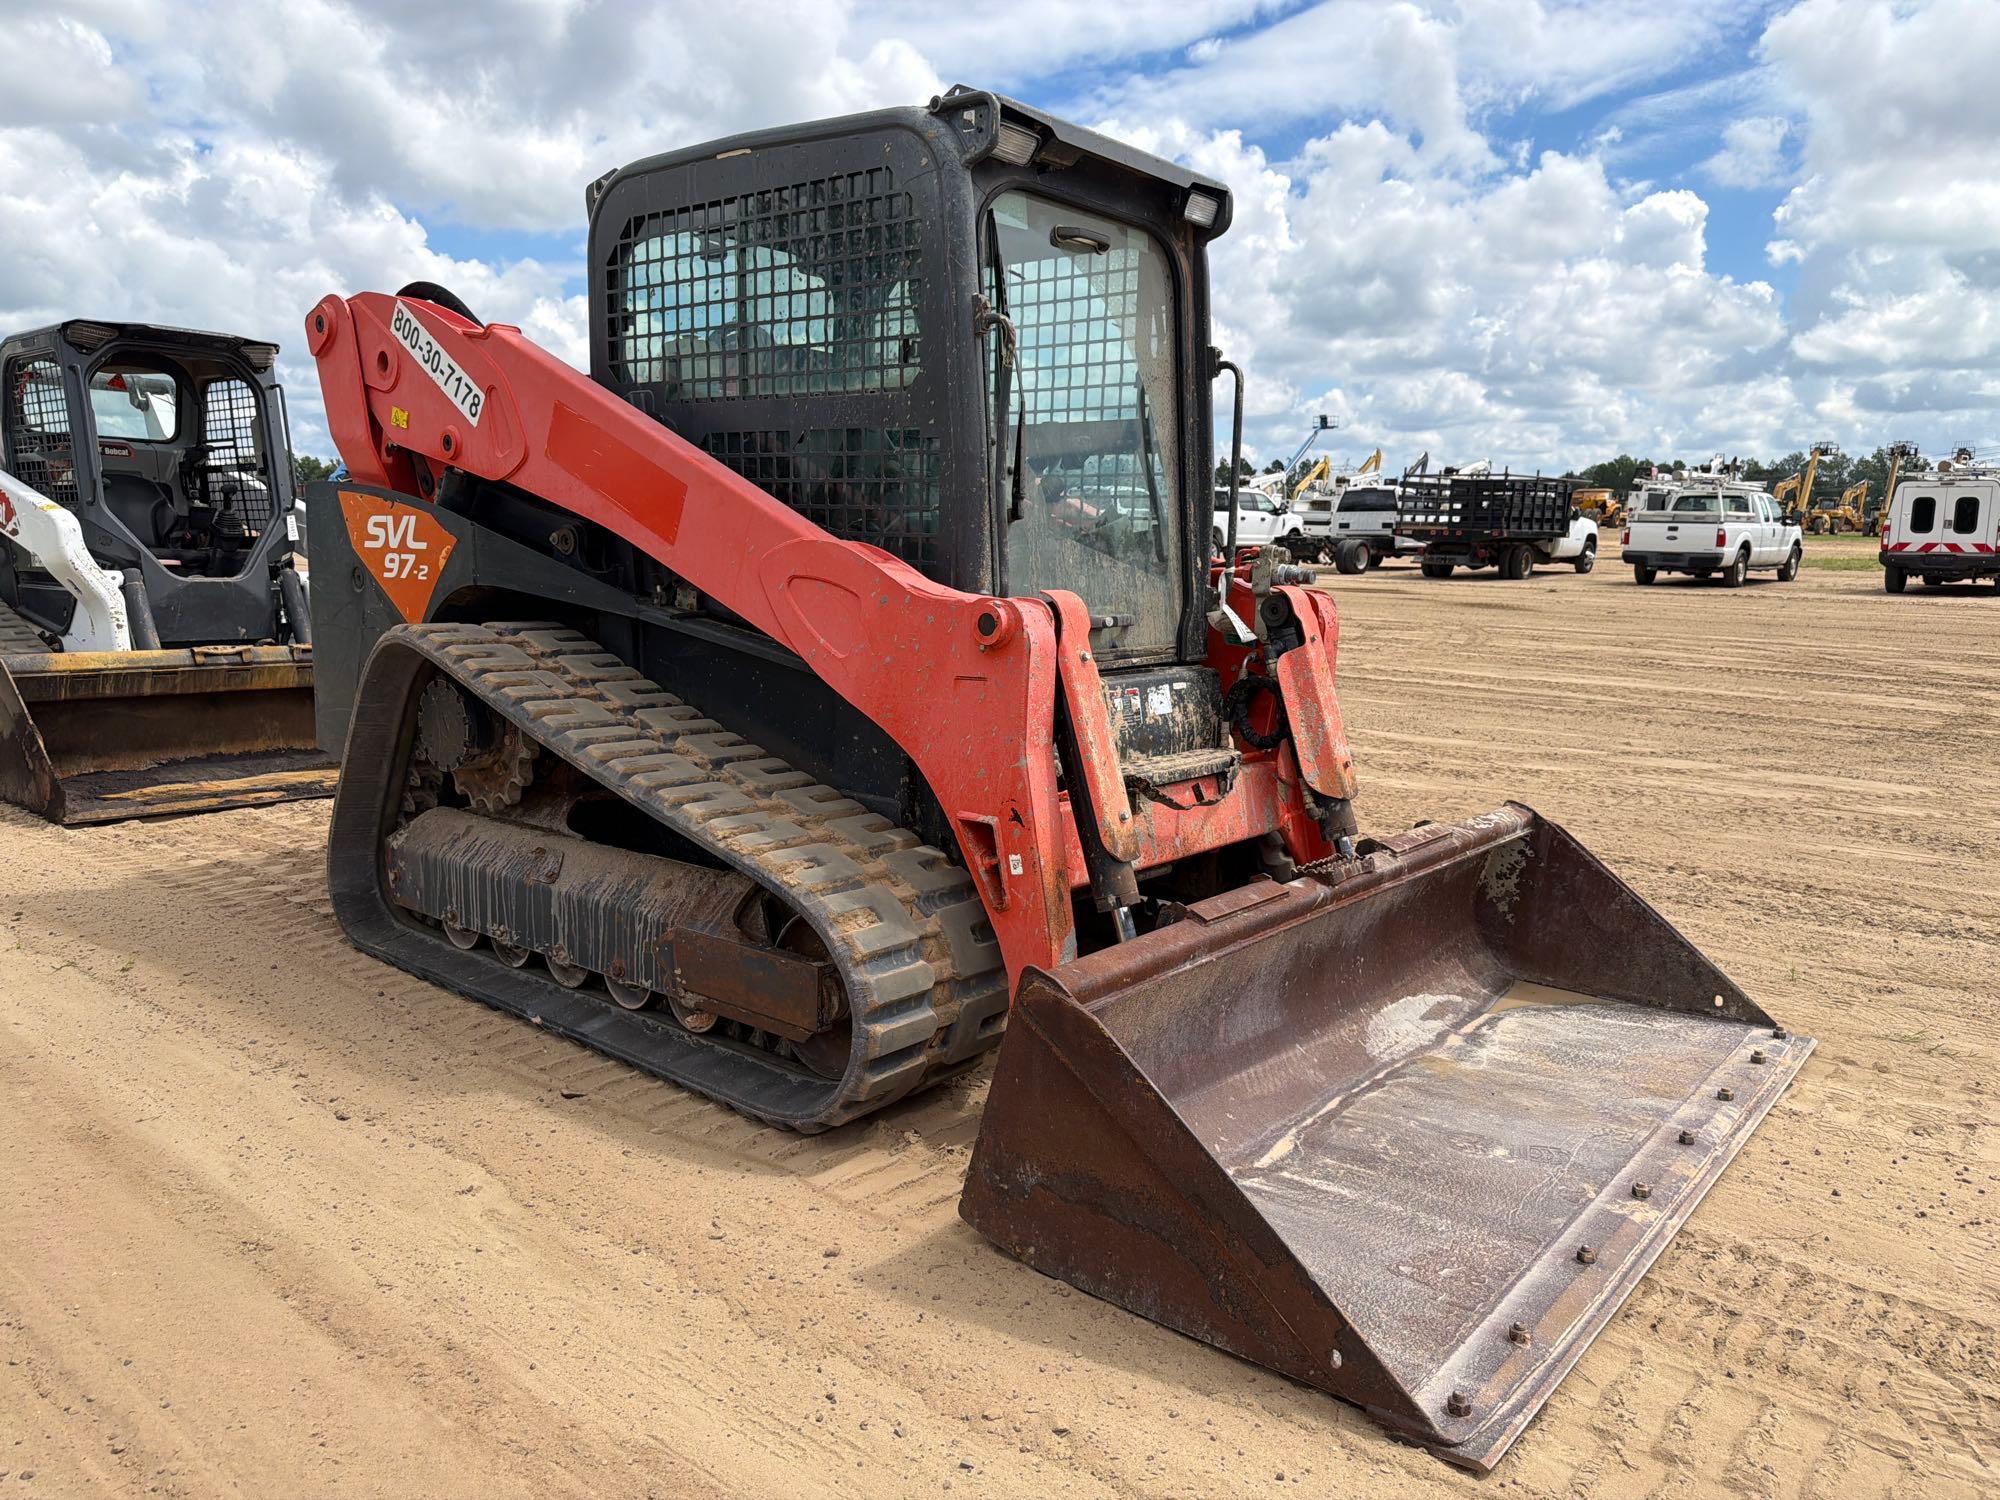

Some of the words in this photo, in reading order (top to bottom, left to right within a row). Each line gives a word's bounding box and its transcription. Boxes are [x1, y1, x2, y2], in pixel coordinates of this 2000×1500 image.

[394, 308, 480, 418] 800-30-7178
[104, 447, 129, 456] Bobcat
[363, 514, 428, 550] SVL
[383, 552, 429, 580] 97-2
